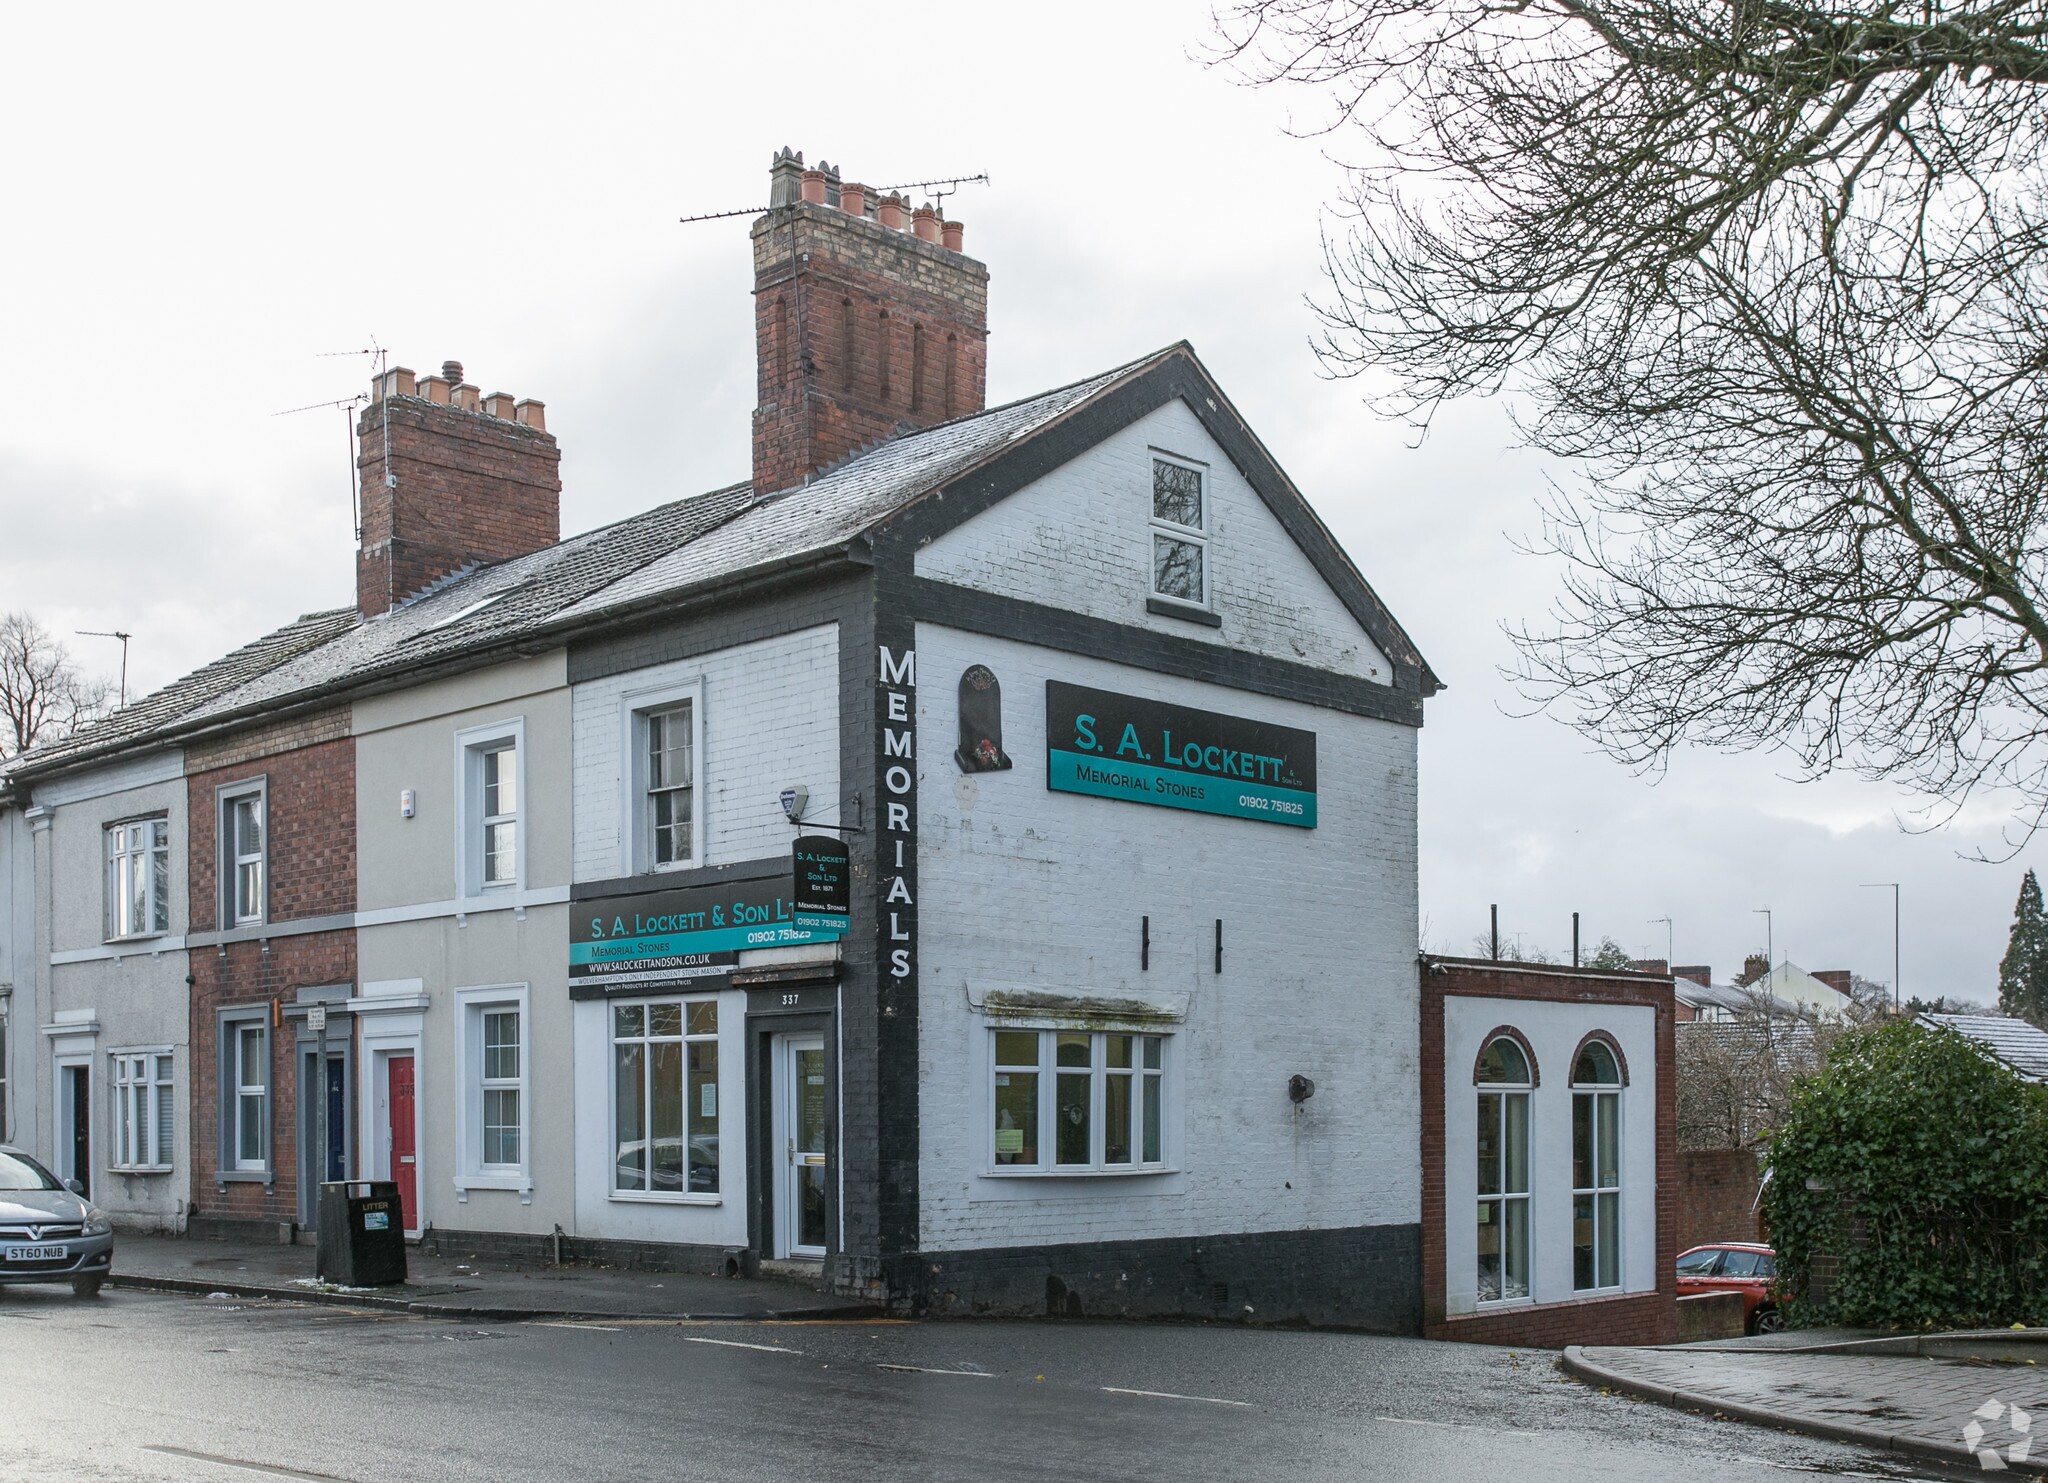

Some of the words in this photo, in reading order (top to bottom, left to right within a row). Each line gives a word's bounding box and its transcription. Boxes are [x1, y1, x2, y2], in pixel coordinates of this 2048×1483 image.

[1075, 714, 1104, 752] S.
[1116, 723, 1151, 760] A.
[1163, 730, 1284, 782] LOCKETT
[1076, 764, 1150, 791] MEMORIAL
[1156, 777, 1205, 800] STONES
[1293, 778, 1303, 786] LTD
[1240, 795, 1268, 810] 01902
[1271, 800, 1303, 815] 751825
[879, 645, 916, 978] MEMORIALS
[797, 853, 804, 861] S.
[807, 853, 815, 861] A.
[816, 854, 847, 864] LOCKETT
[819, 864, 826, 872] &
[807, 873, 822, 881] SON
[824, 873, 837, 882] LTD
[798, 902, 826, 910] MEMORIAL
[827, 903, 847, 912] STONES
[592, 918, 605, 938] S.
[611, 916, 629, 936] A.
[635, 912, 706, 934] LOCKETT
[711, 905, 726, 926] &
[732, 903, 769, 925] SON
[776, 898, 794, 920] LT
[797, 918, 820, 927] 01902
[821, 919, 847, 928] 751825
[747, 931, 775, 943] 01902
[591, 946, 635, 958] MEMORIAL
[637, 942, 670, 954] STONES
[588, 953, 710, 973] WWW.SALOCKETTANDSON.CO.UK
[578, 973, 628, 985] WOLVERHAMPTON'S
[628, 973, 643, 981] ONLY
[643, 970, 680, 980] INDEPENDENT
[682, 968, 700, 977] STONE
[701, 967, 721, 975] MASON
[605, 984, 621, 992] QUALITY
[649, 980, 676, 988] COMPETITIVE
[782, 994, 799, 1005] 337
[363, 1201, 388, 1211] LITTER
[11, 1248, 41, 1258] ST60
[44, 1247, 63, 1258] NUB
